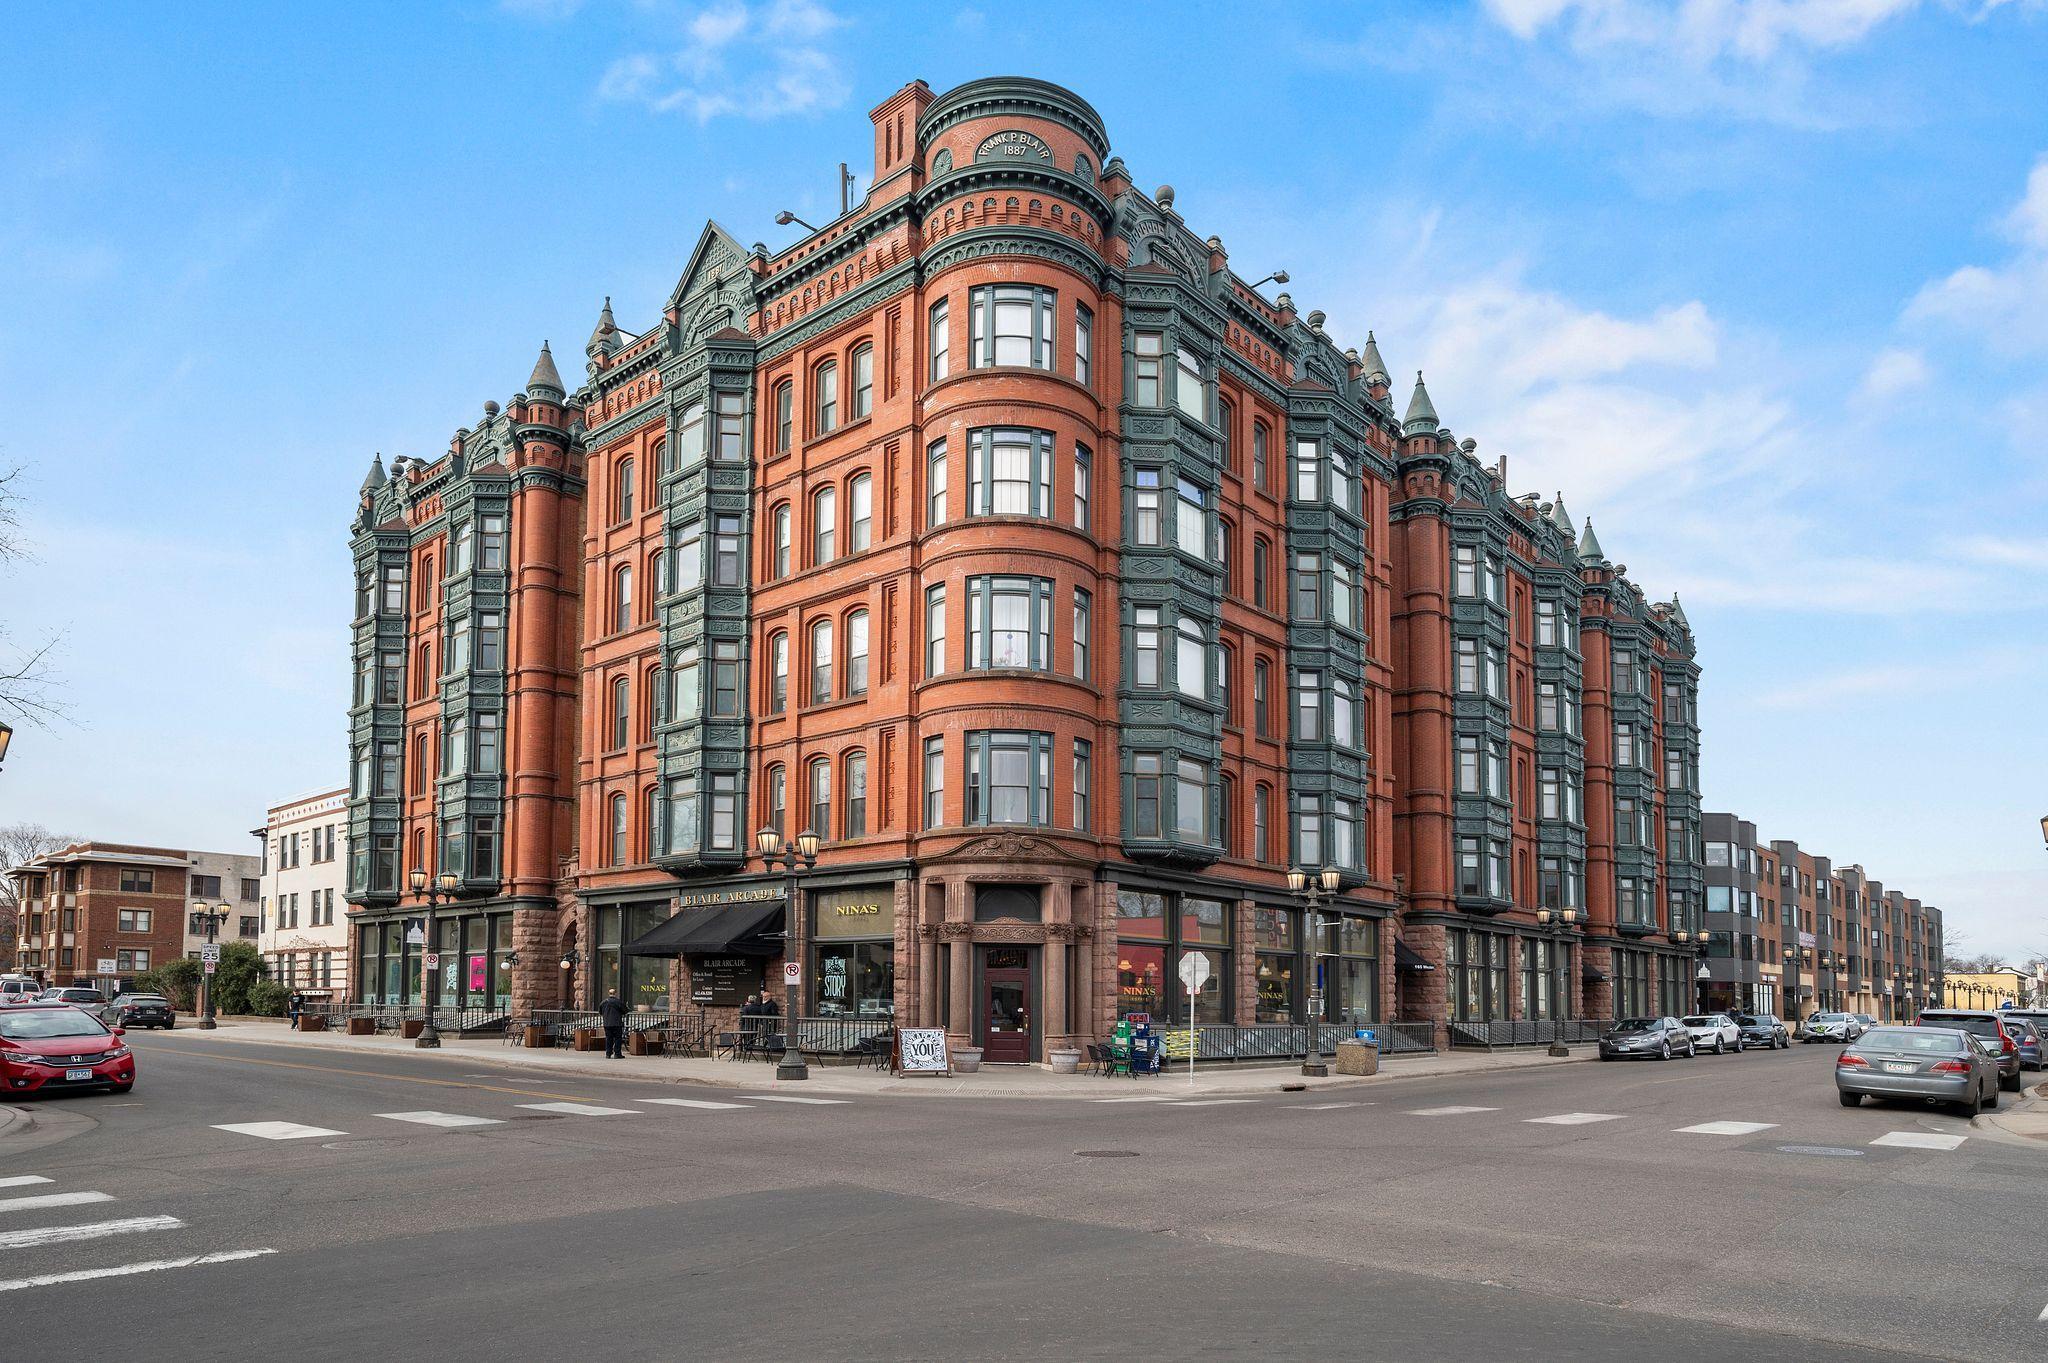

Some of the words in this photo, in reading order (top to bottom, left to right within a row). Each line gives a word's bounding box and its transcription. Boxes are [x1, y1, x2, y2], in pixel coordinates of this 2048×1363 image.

[978, 133, 1008, 156] FRANK
[1020, 133, 1050, 159] BLAIR
[1004, 145, 1027, 156] 1887
[685, 893, 721, 906] BLAIR
[728, 888, 777, 902] ARCADE
[836, 904, 878, 915] NINA'S
[203, 952, 219, 960] 25
[721, 959, 746, 967] ARCADE
[640, 984, 667, 992] NINA'S
[824, 974, 846, 997] STORY
[1123, 987, 1156, 996] NINA'S
[1258, 992, 1284, 1000] NINA'S
[911, 1043, 935, 1057] YOU
